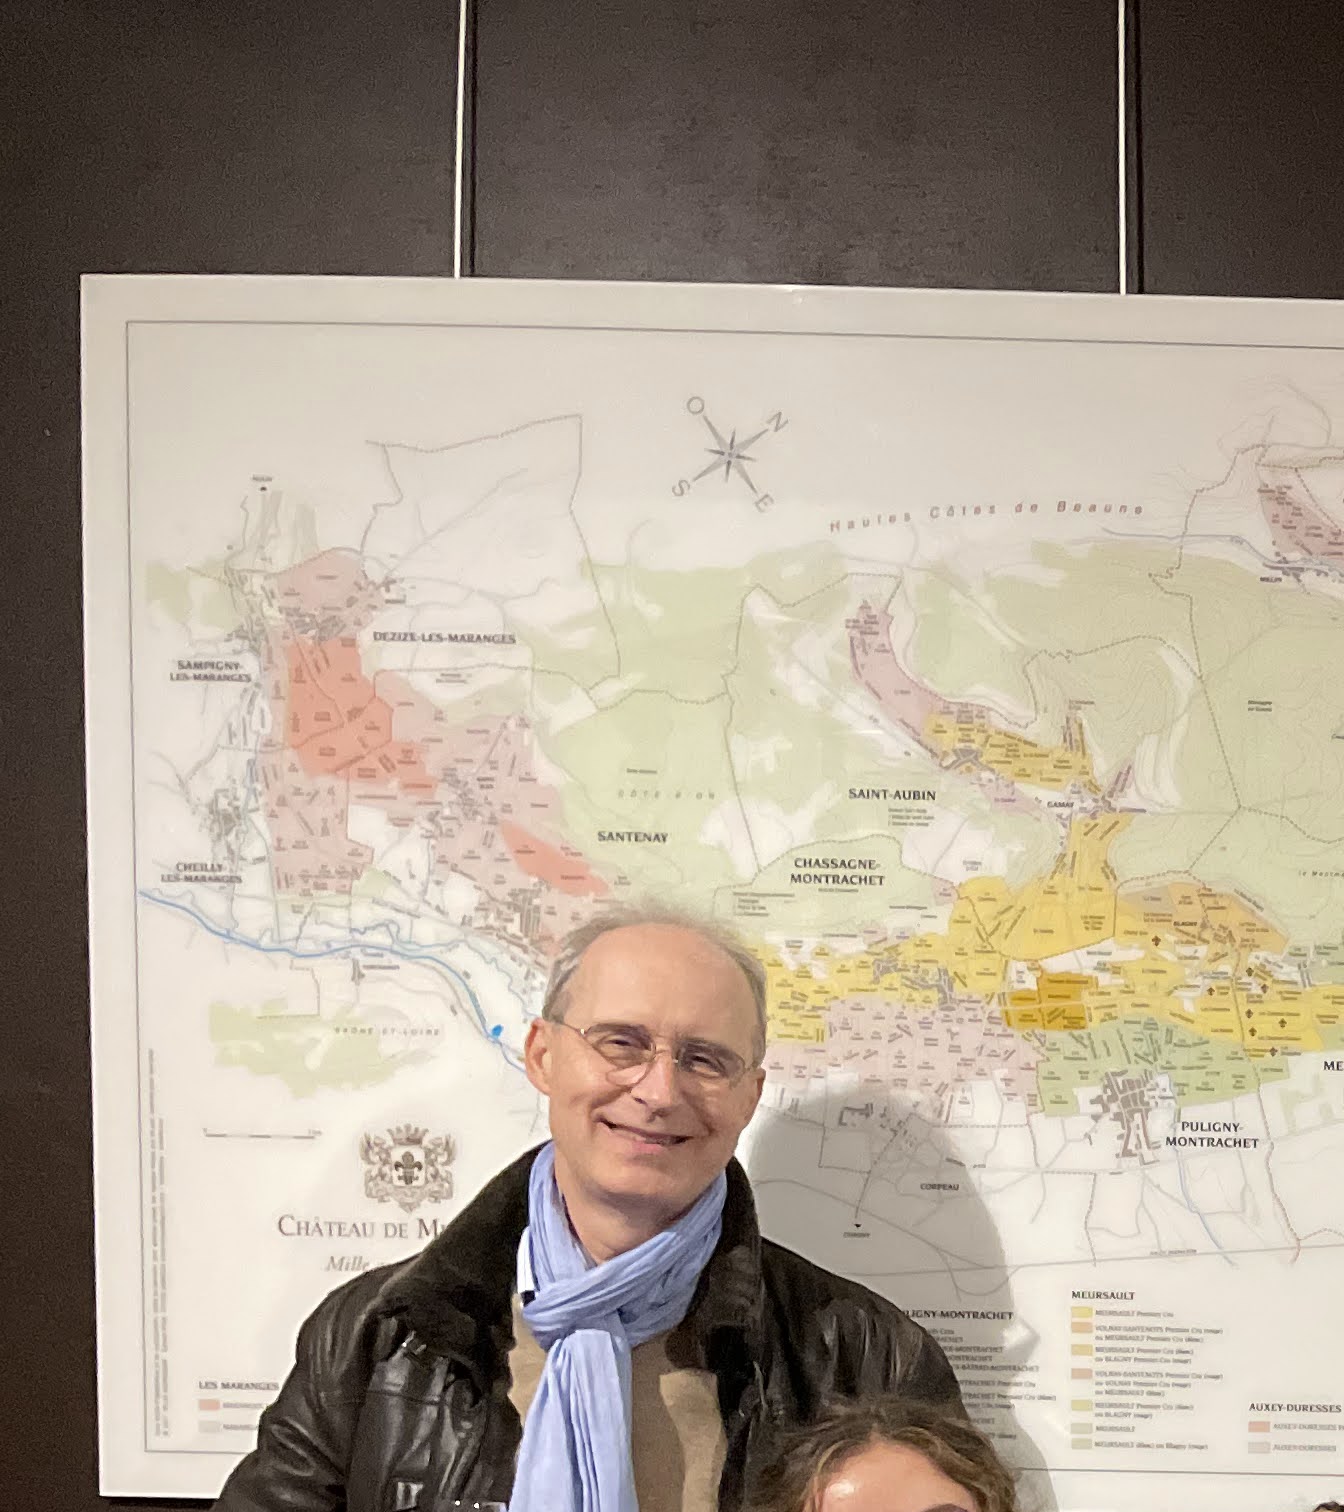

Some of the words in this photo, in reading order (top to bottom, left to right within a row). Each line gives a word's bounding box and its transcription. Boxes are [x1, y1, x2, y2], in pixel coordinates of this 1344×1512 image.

[767, 411, 789, 432] N
[671, 479, 690, 498] S
[755, 494, 774, 513] E
[830, 511, 911, 533] Hautes
[373, 631, 516, 646] DEZIZE-LES-MARANGES
[848, 788, 937, 801] SAINT-AUBIN
[597, 831, 668, 844] SANTENAY
[794, 857, 881, 871] CHASSAGNE-
[790, 873, 885, 887] MONTRACHET
[1181, 1121, 1243, 1134] PULIGNY-
[1166, 1136, 1259, 1149] MONTRACHET
[1071, 1290, 1135, 1300] MEURSAULT
[1249, 1402, 1342, 1413] AUXEY-DURESSES
